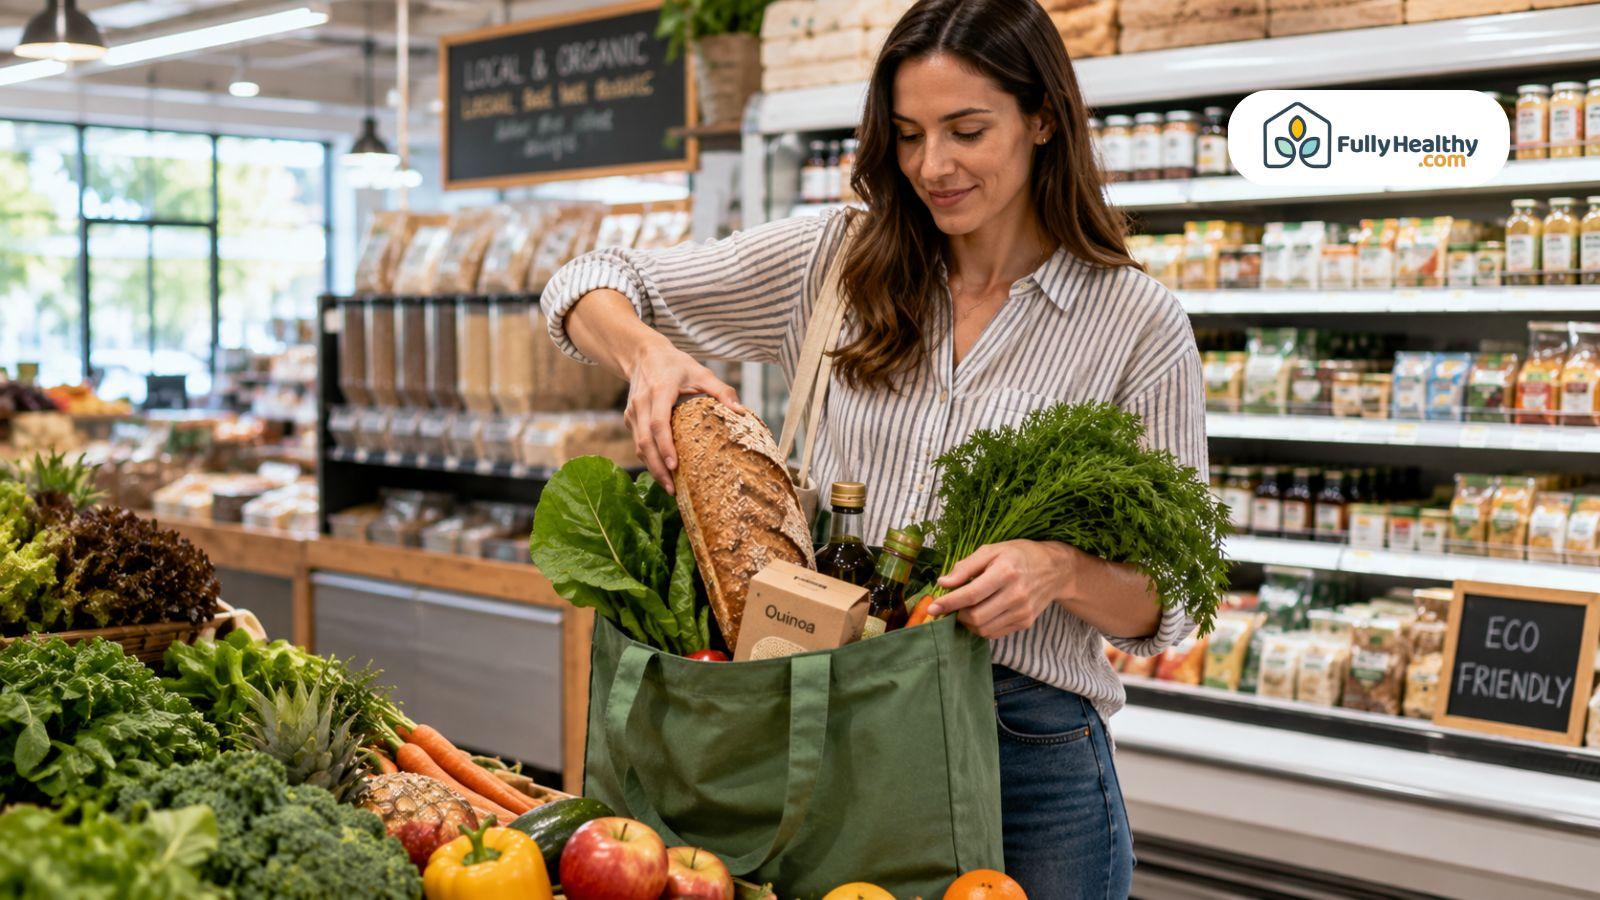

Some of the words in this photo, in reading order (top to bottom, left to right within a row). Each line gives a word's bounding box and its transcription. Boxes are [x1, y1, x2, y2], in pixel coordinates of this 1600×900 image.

[463, 54, 524, 91] LOCAL
[530, 48, 548, 81] &
[556, 31, 649, 78] ORGANIC
[765, 604, 816, 634] Quinoa
[1485, 615, 1540, 653] ECO
[1457, 662, 1572, 708] FRIENDLY
